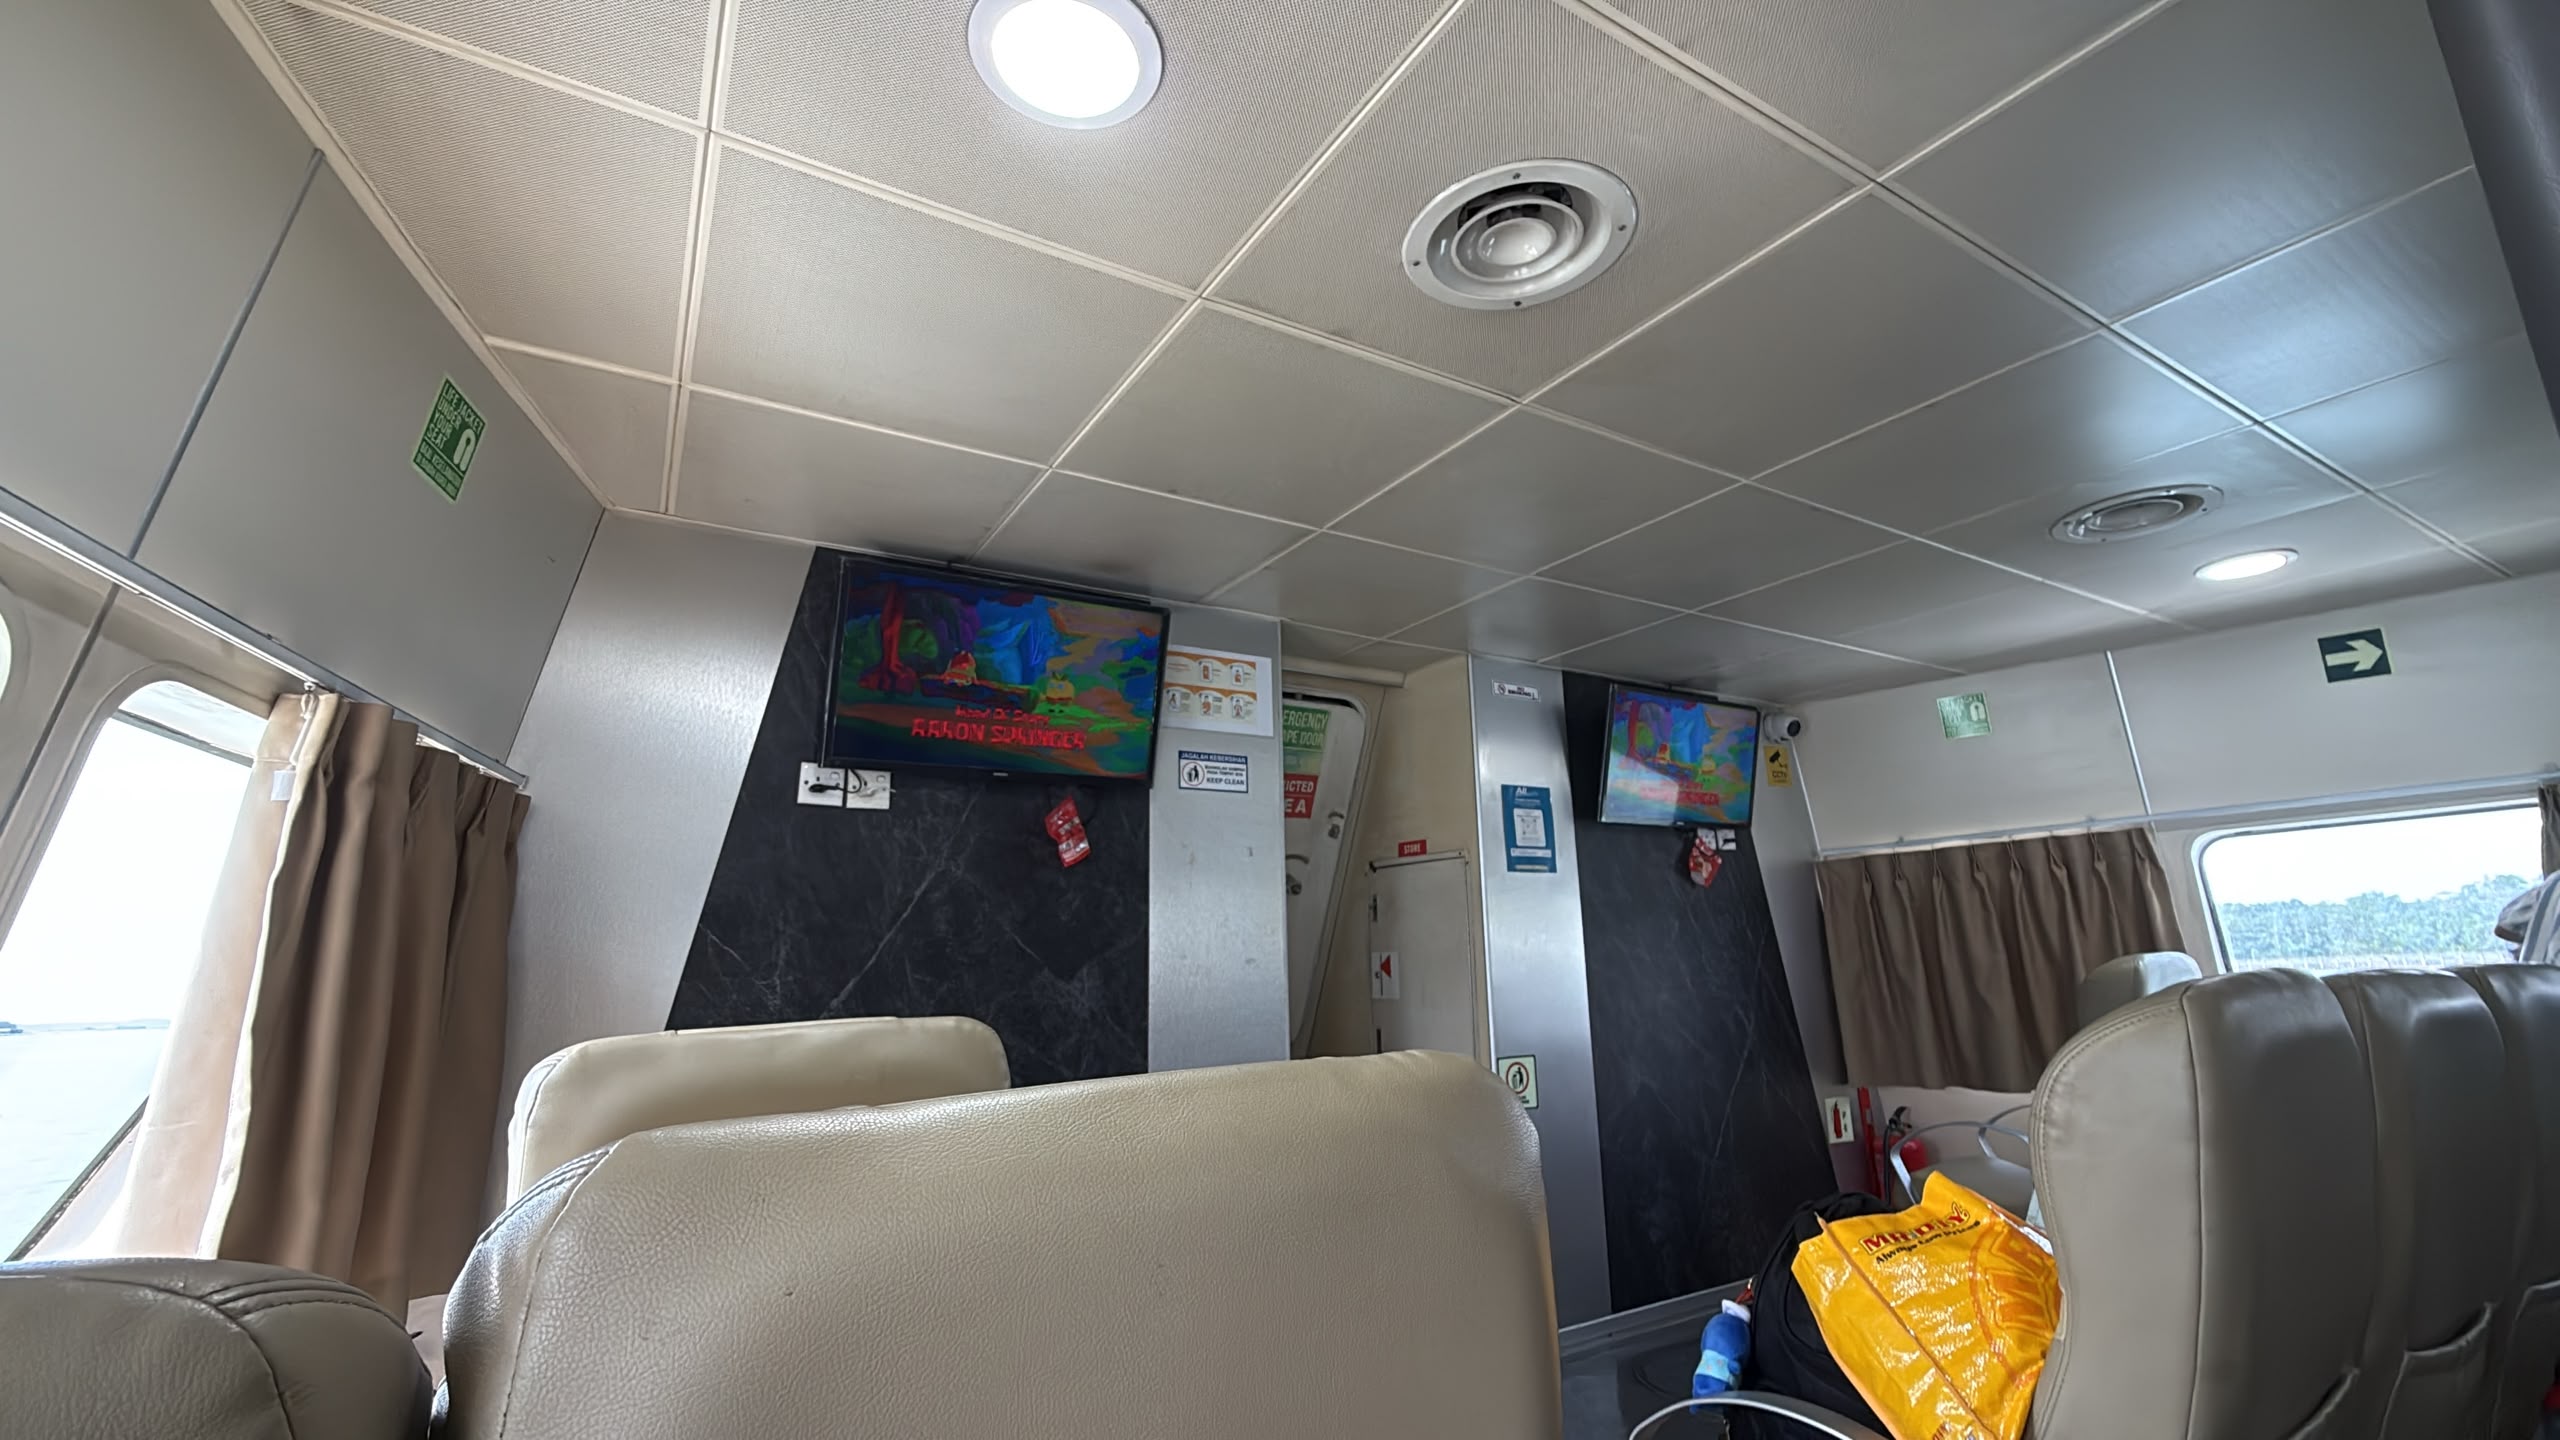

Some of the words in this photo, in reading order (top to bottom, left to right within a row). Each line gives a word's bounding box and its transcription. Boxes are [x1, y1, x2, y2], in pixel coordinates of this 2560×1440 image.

[431, 408, 454, 439] YOUR
[436, 395, 463, 431] UNDER
[441, 381, 460, 408] LIFE
[458, 399, 484, 437] JACKET
[426, 422, 448, 451] SEAT
[1283, 710, 1329, 729] ERGENCY
[1285, 780, 1314, 793] ICTED
